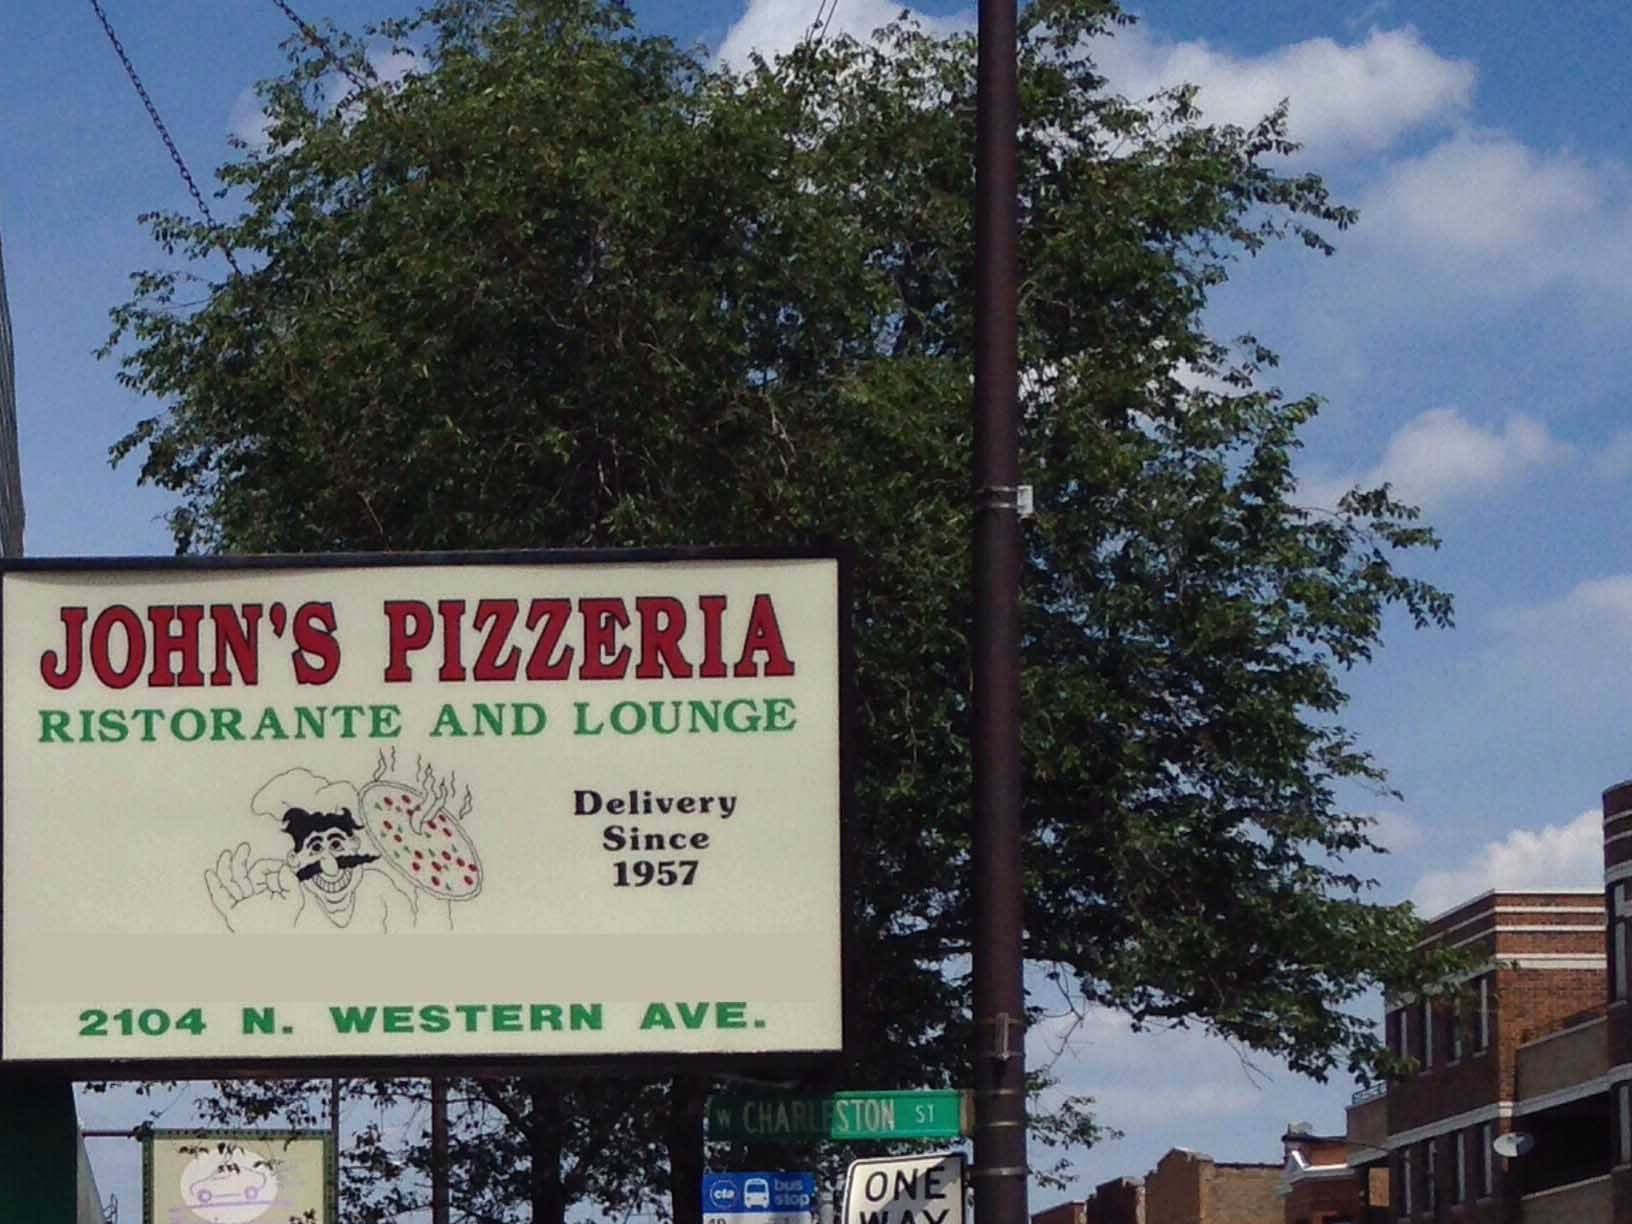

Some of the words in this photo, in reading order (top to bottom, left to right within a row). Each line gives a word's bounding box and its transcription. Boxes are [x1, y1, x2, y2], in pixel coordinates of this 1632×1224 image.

[40, 601, 342, 689] JOHN'S
[383, 593, 795, 683] PIZZERIA
[37, 704, 402, 743] RISTORANTE
[430, 700, 548, 736] AND
[572, 698, 797, 735] LOUNGE
[573, 789, 739, 819] Delivery
[602, 825, 711, 852] Since
[612, 859, 701, 889] 1957
[78, 1009, 207, 1038] 2104
[241, 1008, 295, 1035] N.
[330, 1004, 605, 1035] WESTERN
[639, 1001, 768, 1031] AVE.
[717, 1108, 731, 1129] W
[742, 1098, 896, 1135] CHARLESTON
[914, 1104, 936, 1124] ST
[774, 1179, 803, 1191] bus
[865, 1165, 947, 1202] ONE
[775, 1193, 810, 1208] stop
